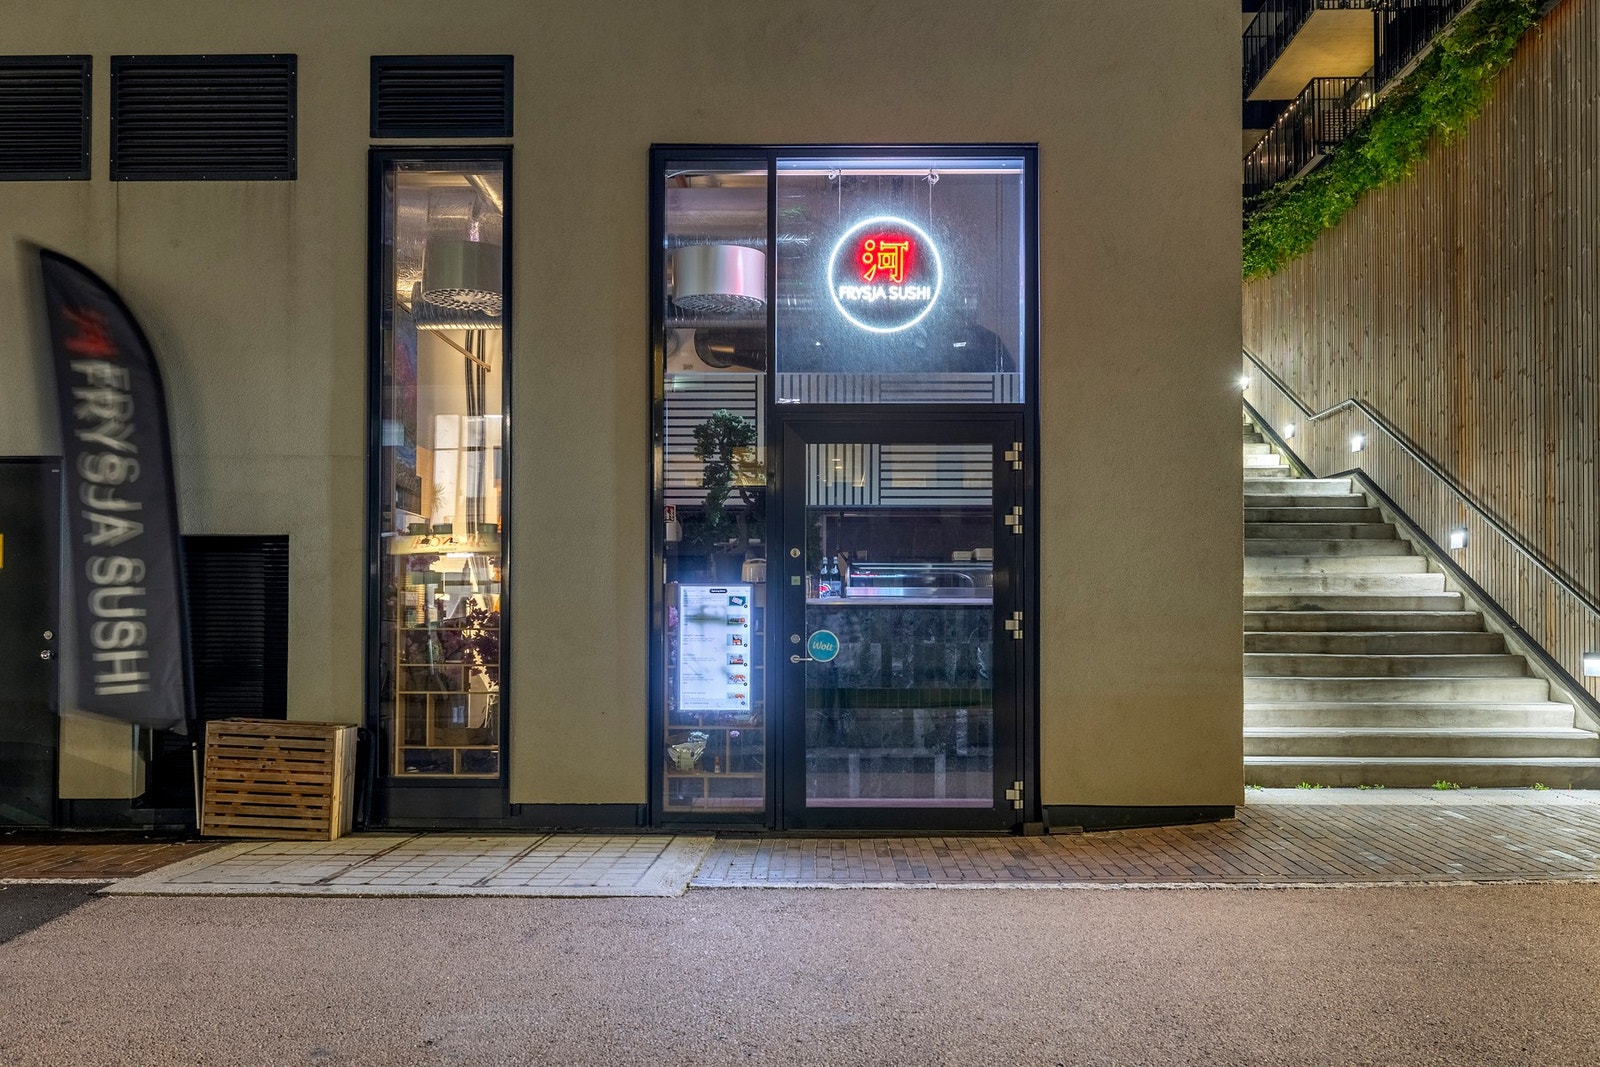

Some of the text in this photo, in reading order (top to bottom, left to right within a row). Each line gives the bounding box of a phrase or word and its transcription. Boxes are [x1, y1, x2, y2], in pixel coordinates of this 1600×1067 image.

[862, 239, 909, 283] 河
[839, 285, 931, 302] FRYSJA SUSHI
[69, 359, 144, 547] FRYSJA
[85, 556, 149, 696] SUSHI
[812, 641, 835, 652] Wolt
